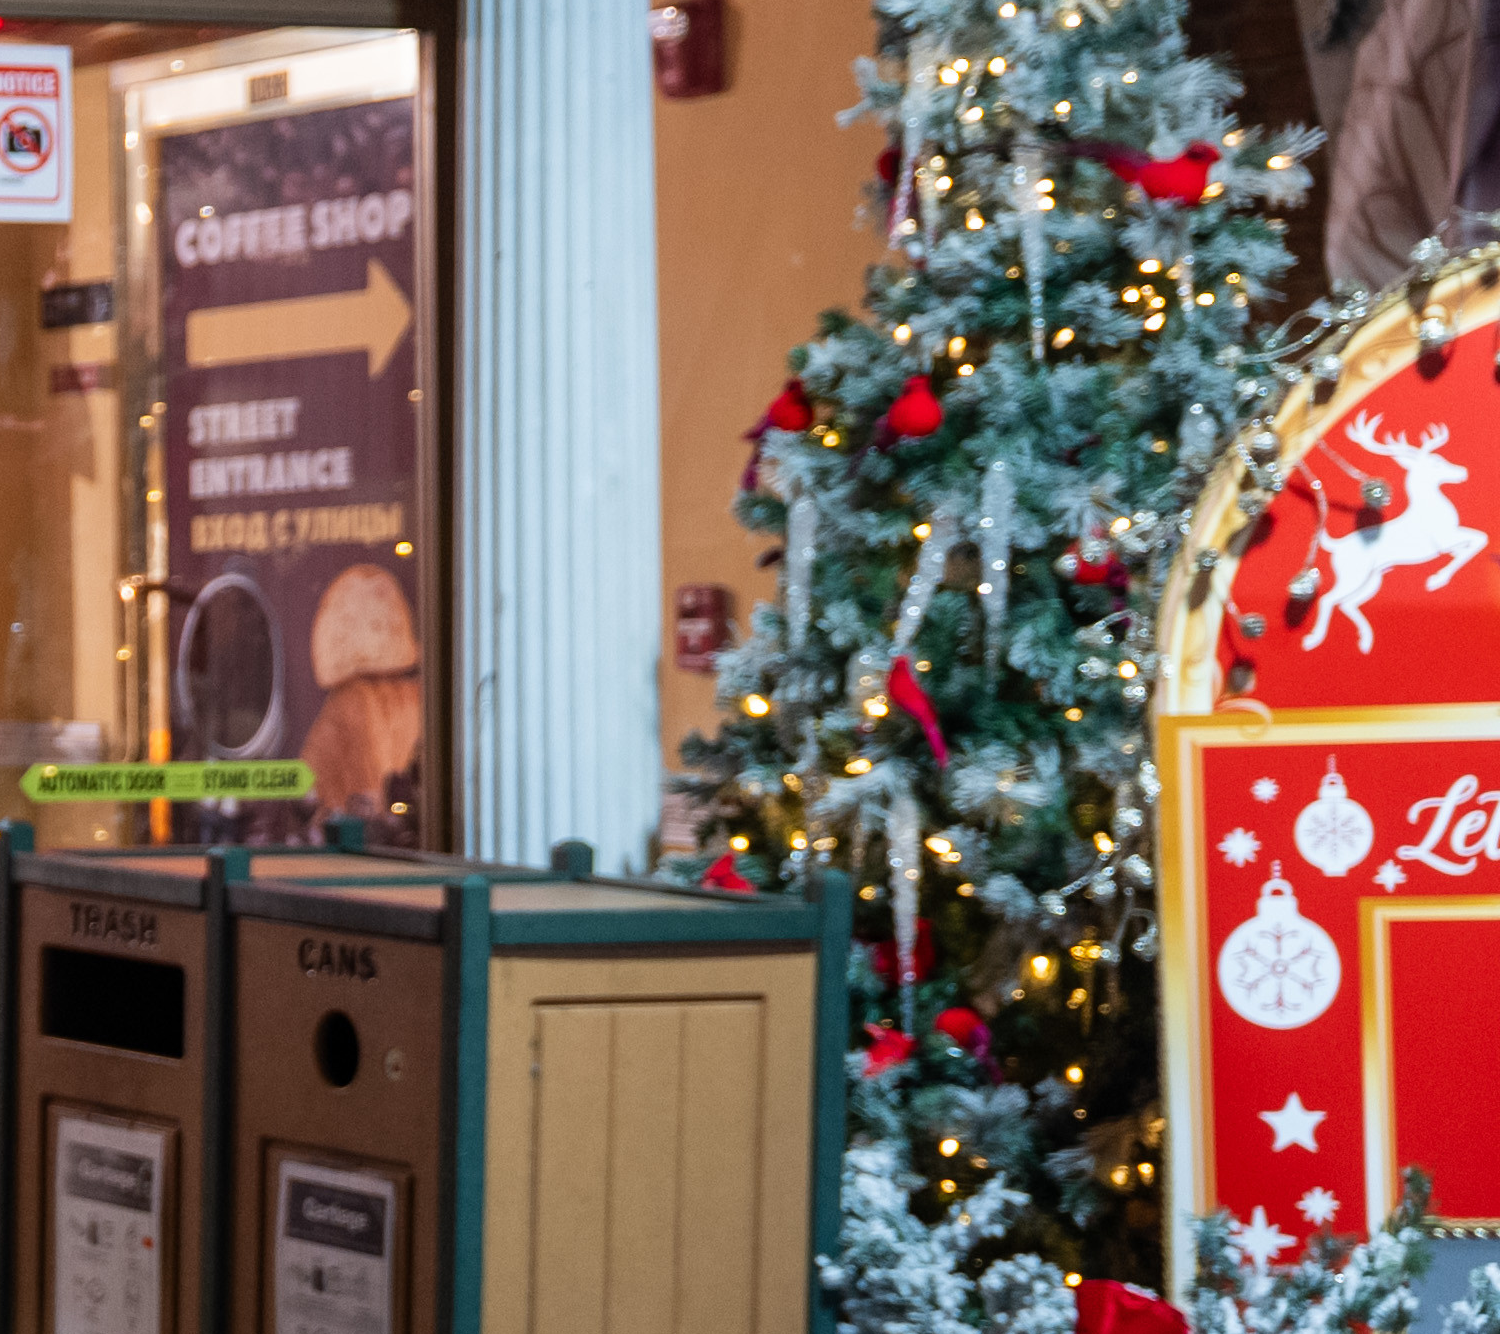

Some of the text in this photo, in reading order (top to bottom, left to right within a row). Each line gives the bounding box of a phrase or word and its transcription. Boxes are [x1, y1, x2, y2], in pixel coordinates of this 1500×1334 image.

[175, 189, 411, 267] COFFEE SHOP
[188, 397, 300, 447] STREET
[188, 446, 350, 499] ENTRANCE
[38, 769, 122, 792] AUTOMATIC
[125, 769, 166, 791] DOOR
[203, 769, 248, 789] STAND
[251, 768, 298, 789] CLEAR
[1396, 774, 1500, 877] Let
[69, 901, 158, 945] TRASH
[298, 937, 377, 982] CANS
